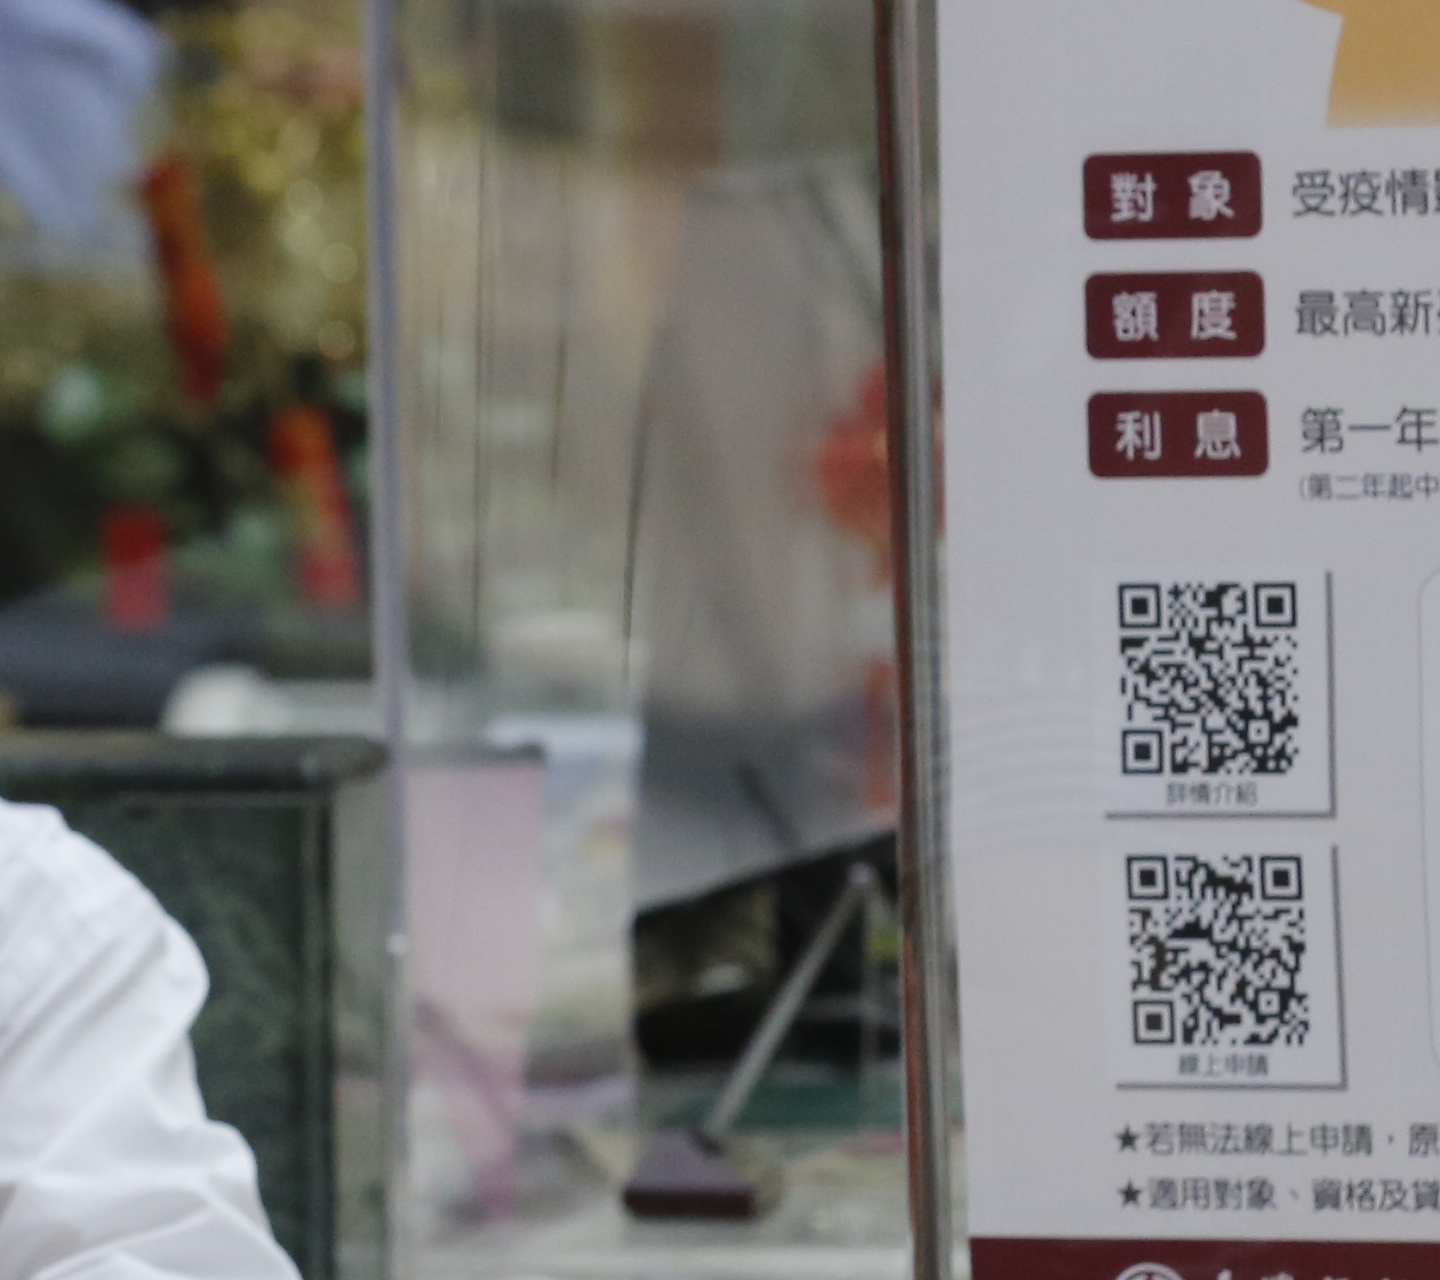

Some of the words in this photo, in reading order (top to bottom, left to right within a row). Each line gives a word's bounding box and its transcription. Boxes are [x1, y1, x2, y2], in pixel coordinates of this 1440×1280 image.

[1110, 170, 1234, 222] 對象
[1112, 291, 1237, 342] 額度
[1116, 408, 1241, 461] 利息
